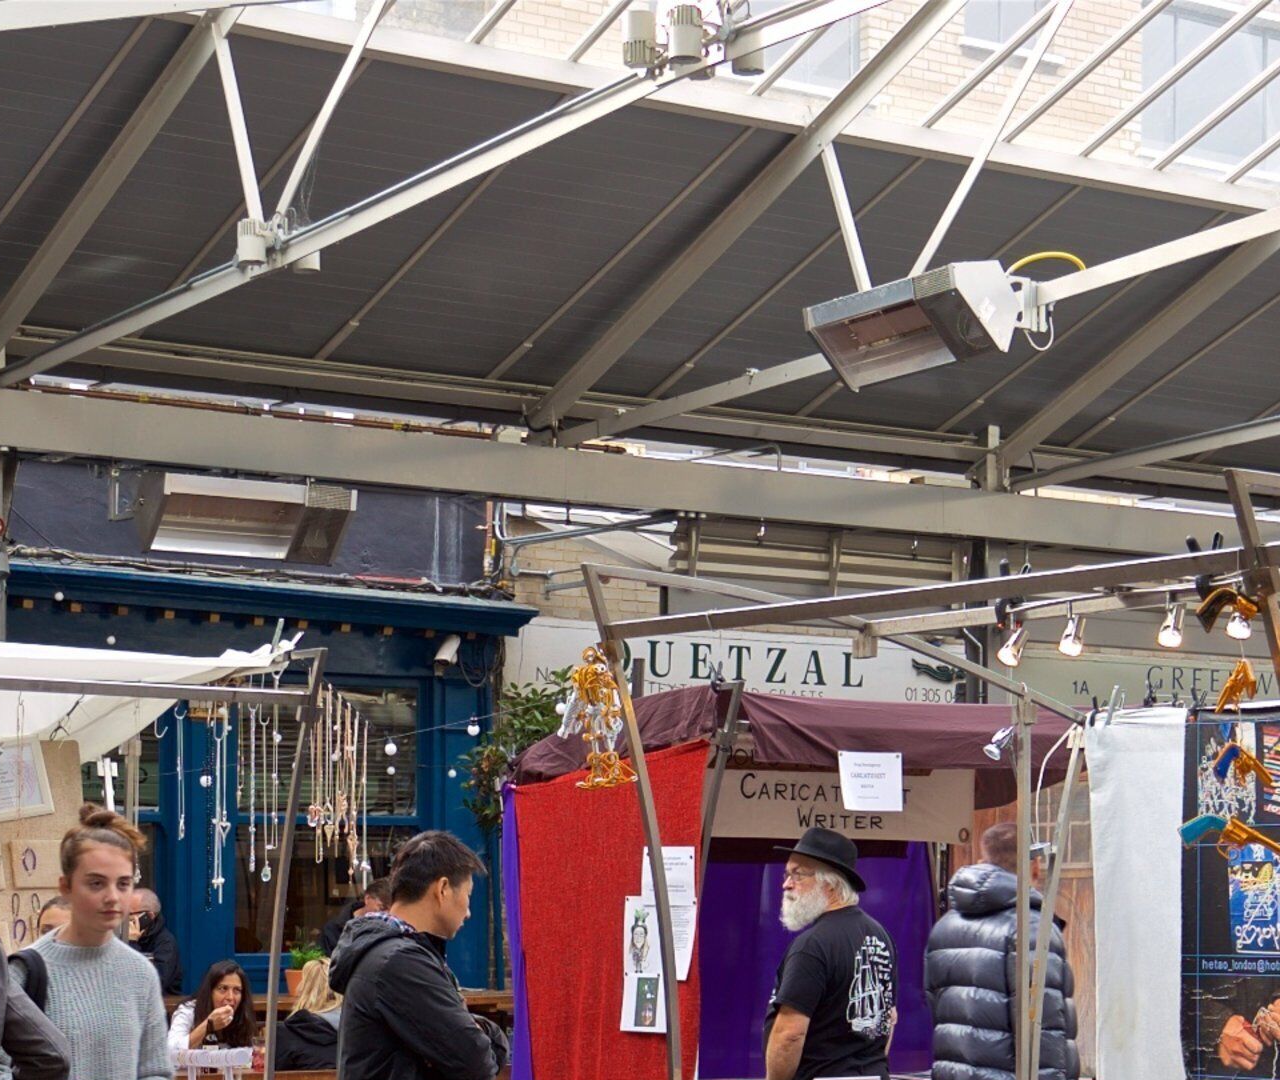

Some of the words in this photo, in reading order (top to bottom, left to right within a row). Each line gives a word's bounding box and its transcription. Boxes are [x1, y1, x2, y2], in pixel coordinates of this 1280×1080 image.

[921, 687, 941, 704] 305
[1072, 680, 1090, 695] 1A
[740, 772, 911, 805] CARICATT
[797, 806, 884, 830] WRITER
